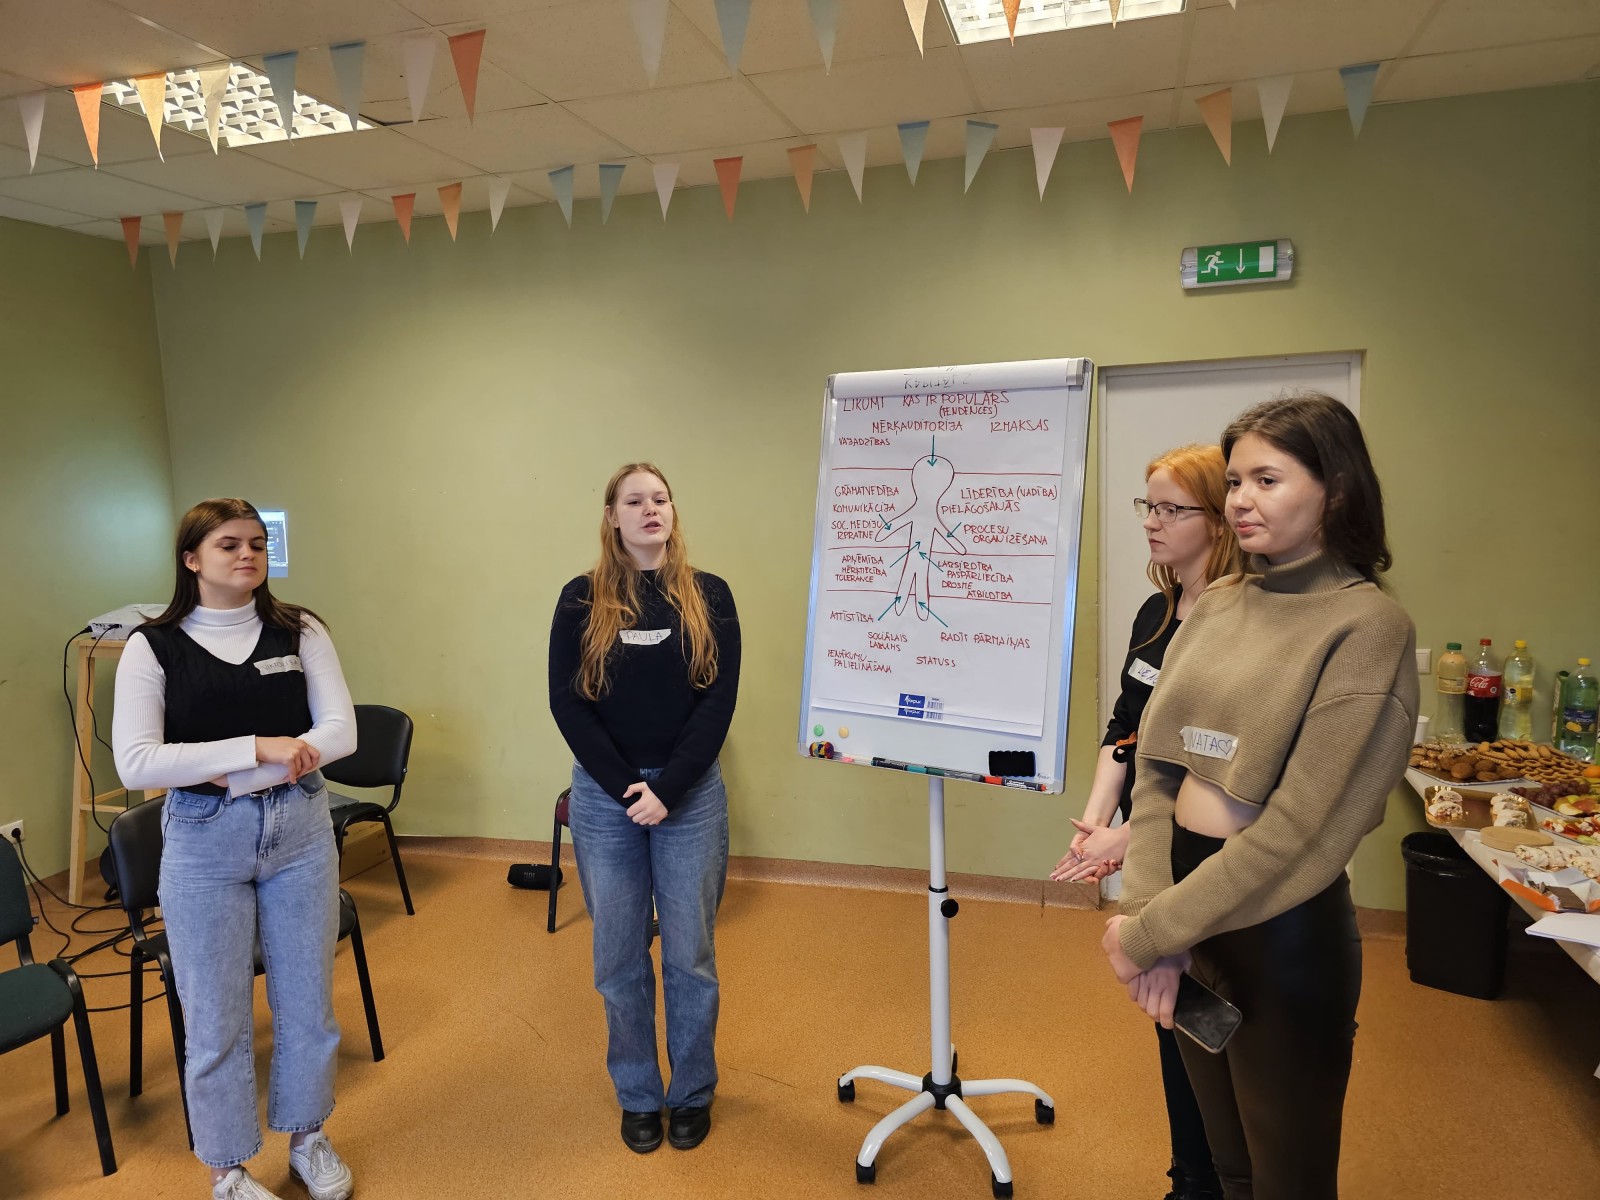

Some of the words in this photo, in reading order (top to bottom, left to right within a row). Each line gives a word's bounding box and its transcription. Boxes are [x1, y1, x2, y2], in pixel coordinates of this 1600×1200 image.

[843, 396, 884, 411] LIKUMI
[903, 395, 920, 407] KAS
[926, 394, 937, 406] IR
[941, 391, 1009, 406] POPULĀRS
[990, 419, 1049, 433] IZMAKSAS
[834, 484, 899, 497] GRĀMATVEDĪBA
[961, 487, 1014, 500] LĪDERĪBA
[831, 520, 849, 530] SOC.
[963, 524, 1009, 535] PROCESU
[837, 530, 874, 540] IZPRATNE
[835, 574, 874, 583] TOLERANCE
[941, 580, 973, 590] DROSME
[626, 631, 662, 642] PAULA
[916, 656, 956, 668] STATUSS
